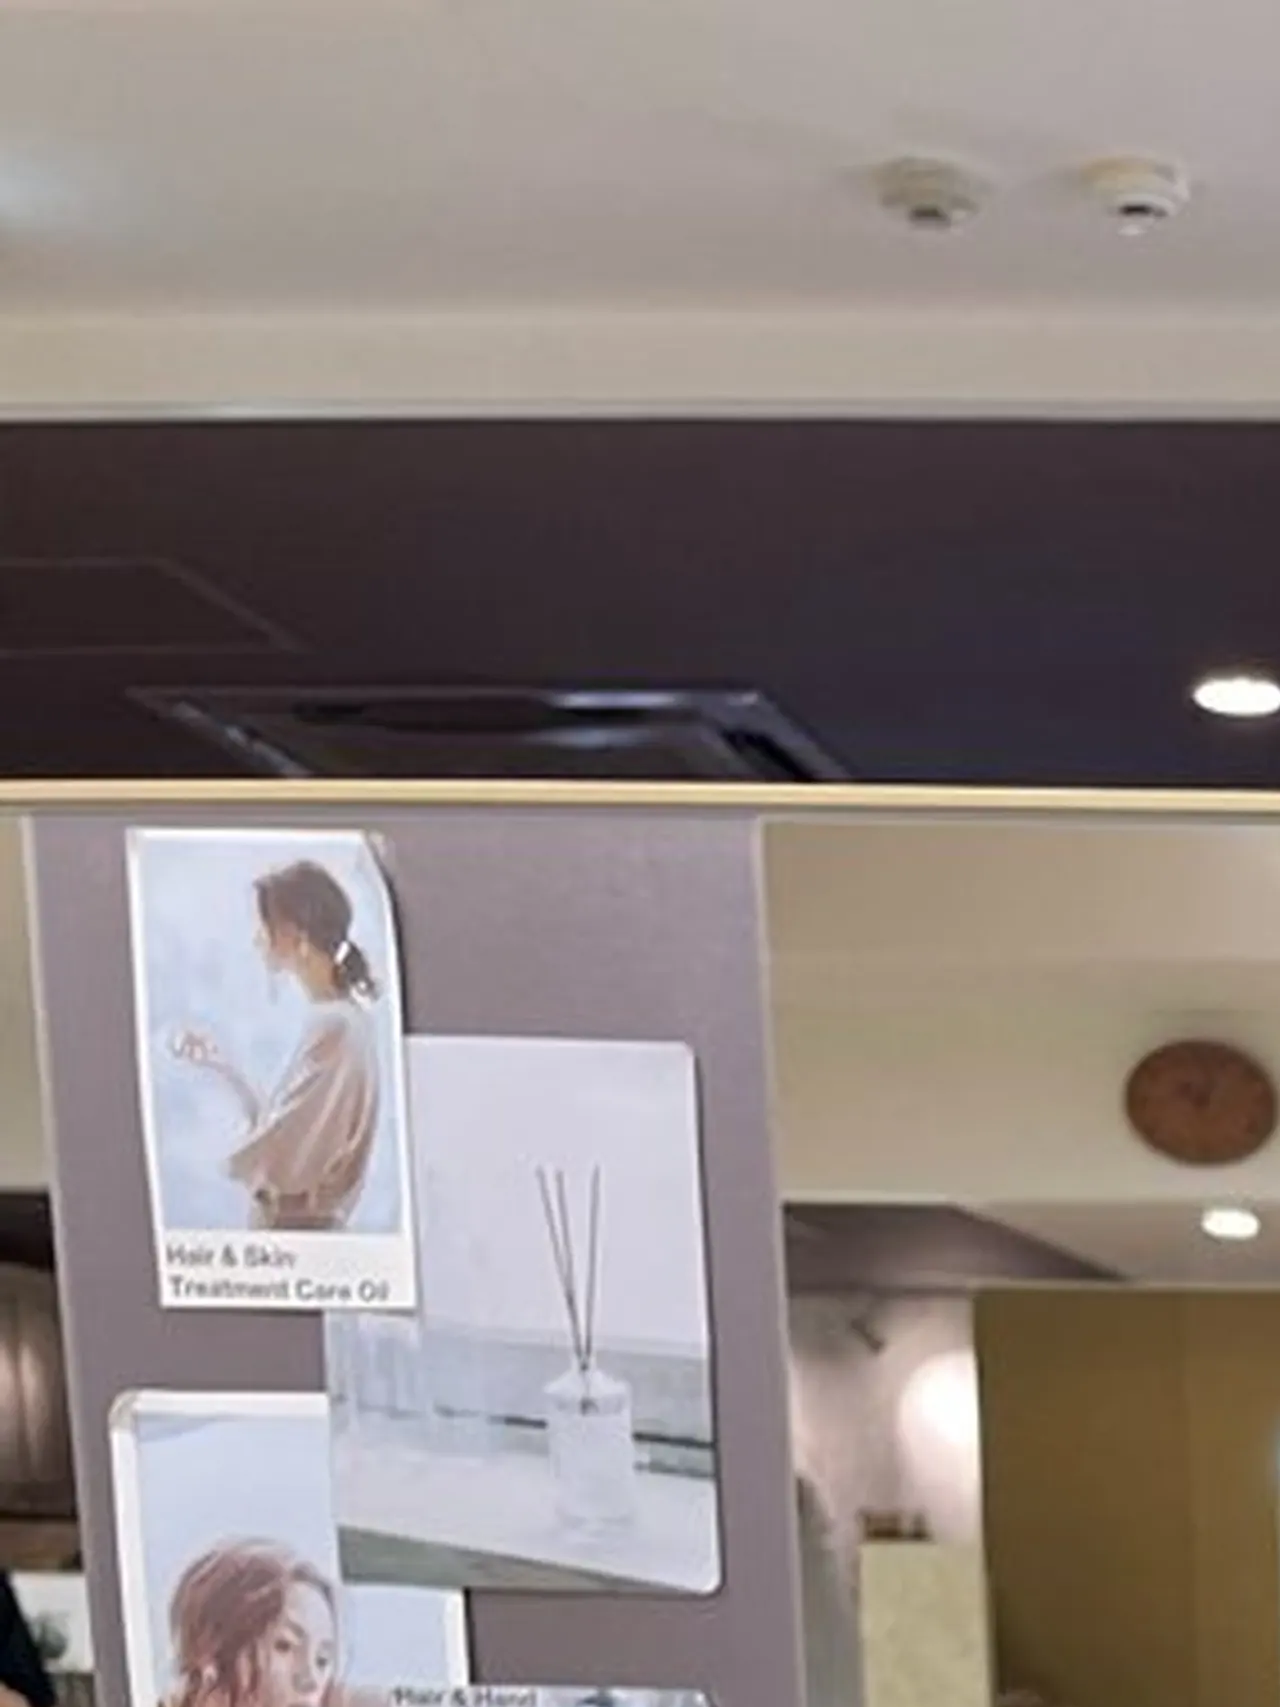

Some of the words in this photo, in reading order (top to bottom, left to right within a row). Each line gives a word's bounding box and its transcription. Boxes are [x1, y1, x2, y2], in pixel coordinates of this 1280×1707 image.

[166, 1243, 214, 1267] Hair
[220, 1244, 238, 1267] &
[244, 1245, 297, 1268] Skin
[169, 1275, 289, 1300] Treatment
[394, 1687, 445, 1706] Hair
[450, 1688, 467, 1707] &
[474, 1688, 537, 1707] Hand
